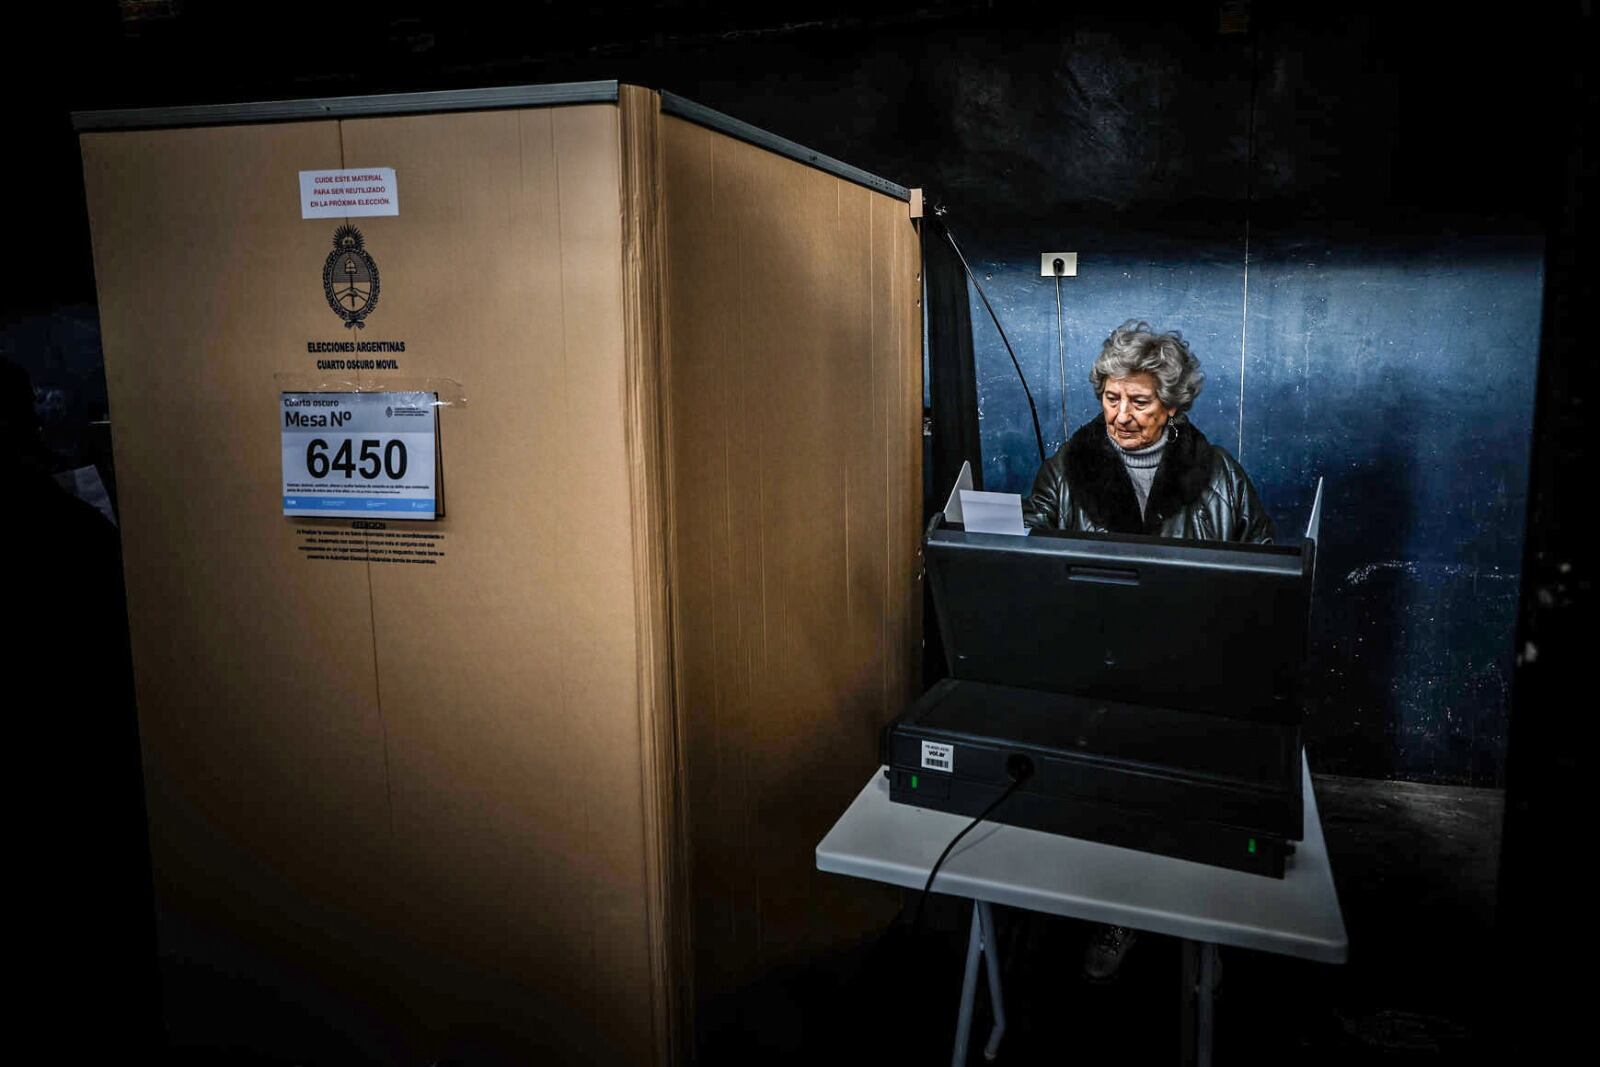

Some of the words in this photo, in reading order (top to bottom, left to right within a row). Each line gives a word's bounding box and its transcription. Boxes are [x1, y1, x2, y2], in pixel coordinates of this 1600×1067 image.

[314, 176, 334, 184] CUIDE
[335, 175, 350, 183] ESTE
[351, 173, 383, 182] MATERIAL
[345, 186, 386, 194] REUTILIZADO
[329, 198, 357, 207] PRÓXIMA
[307, 341, 355, 353] ELECCIONES
[356, 341, 406, 352] ARGENTINAS
[317, 359, 345, 370] CUARTO
[346, 359, 375, 370] OSCURO
[375, 359, 399, 369] MOVIL
[284, 398, 311, 407] Cuarto
[313, 399, 339, 407] oscuro
[285, 411, 327, 427] Mesa
[306, 438, 408, 480] 6450
